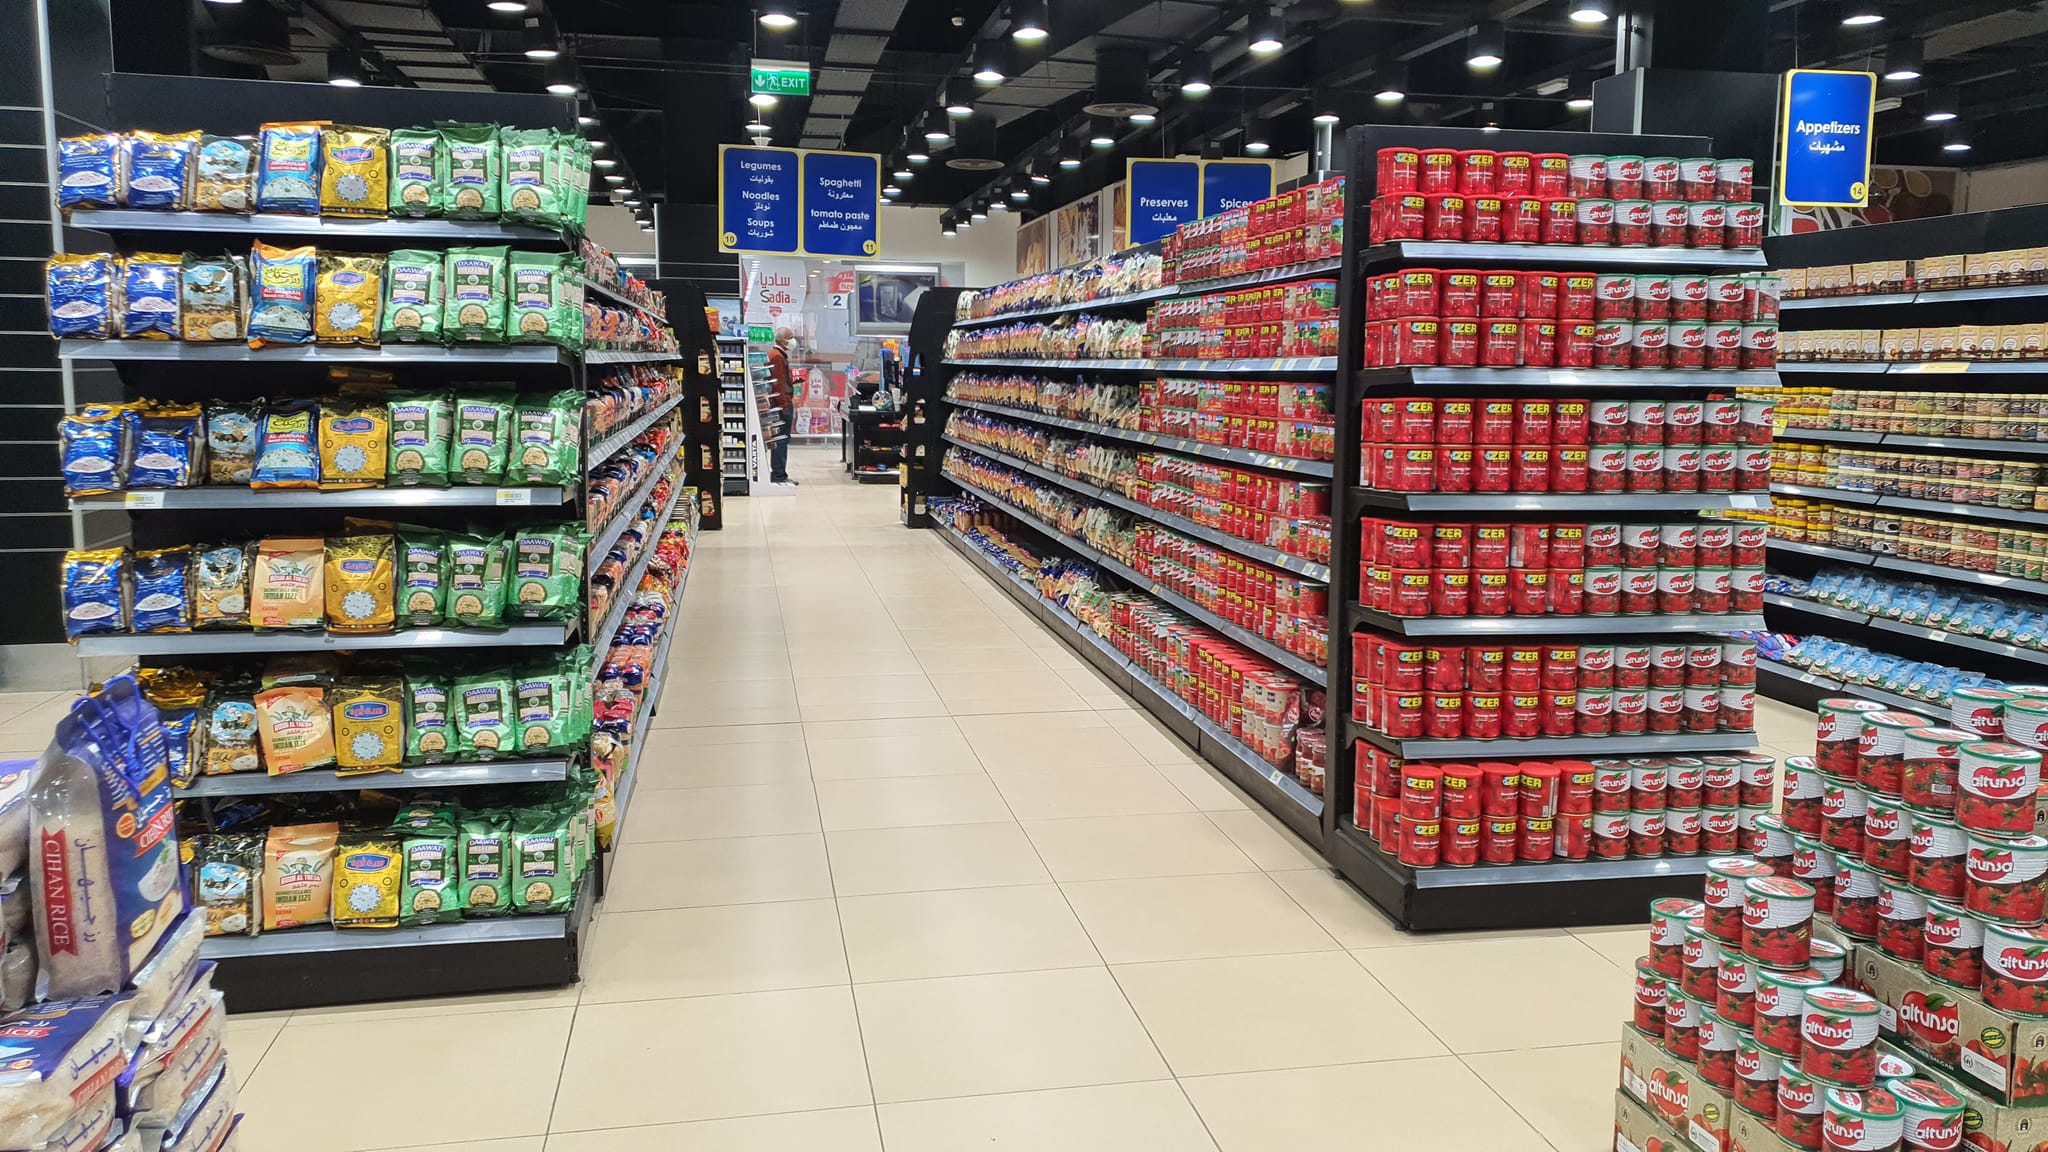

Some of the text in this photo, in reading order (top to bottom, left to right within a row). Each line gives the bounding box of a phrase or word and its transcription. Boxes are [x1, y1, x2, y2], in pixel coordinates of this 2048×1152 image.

[781, 77, 806, 88] EXIT
[1796, 120, 1860, 136] Appetizers
[1809, 140, 1846, 154] مشهيات
[740, 160, 782, 171] Legumes
[750, 174, 774, 184] بقوليات
[819, 178, 862, 188] Spaghetti
[742, 190, 780, 200] Noodles
[753, 202, 770, 212] نودلز
[1140, 198, 1188, 208] Preserves
[810, 208, 870, 221] tomato paste
[1152, 212, 1177, 222] معلبات
[746, 218, 774, 228] Soups
[818, 220, 862, 232] معجون طماطم
[760, 272, 790, 288] ساديا
[760, 290, 790, 304] Sadia
[832, 295, 842, 306] 2
[1972, 776, 2026, 788] altunsa
[44, 840, 70, 946] CIHAN RICE
[1900, 1003, 1960, 1035] altunsa
[1804, 1022, 1853, 1040] altunsa
[1649, 1078, 1688, 1109] altunsa
